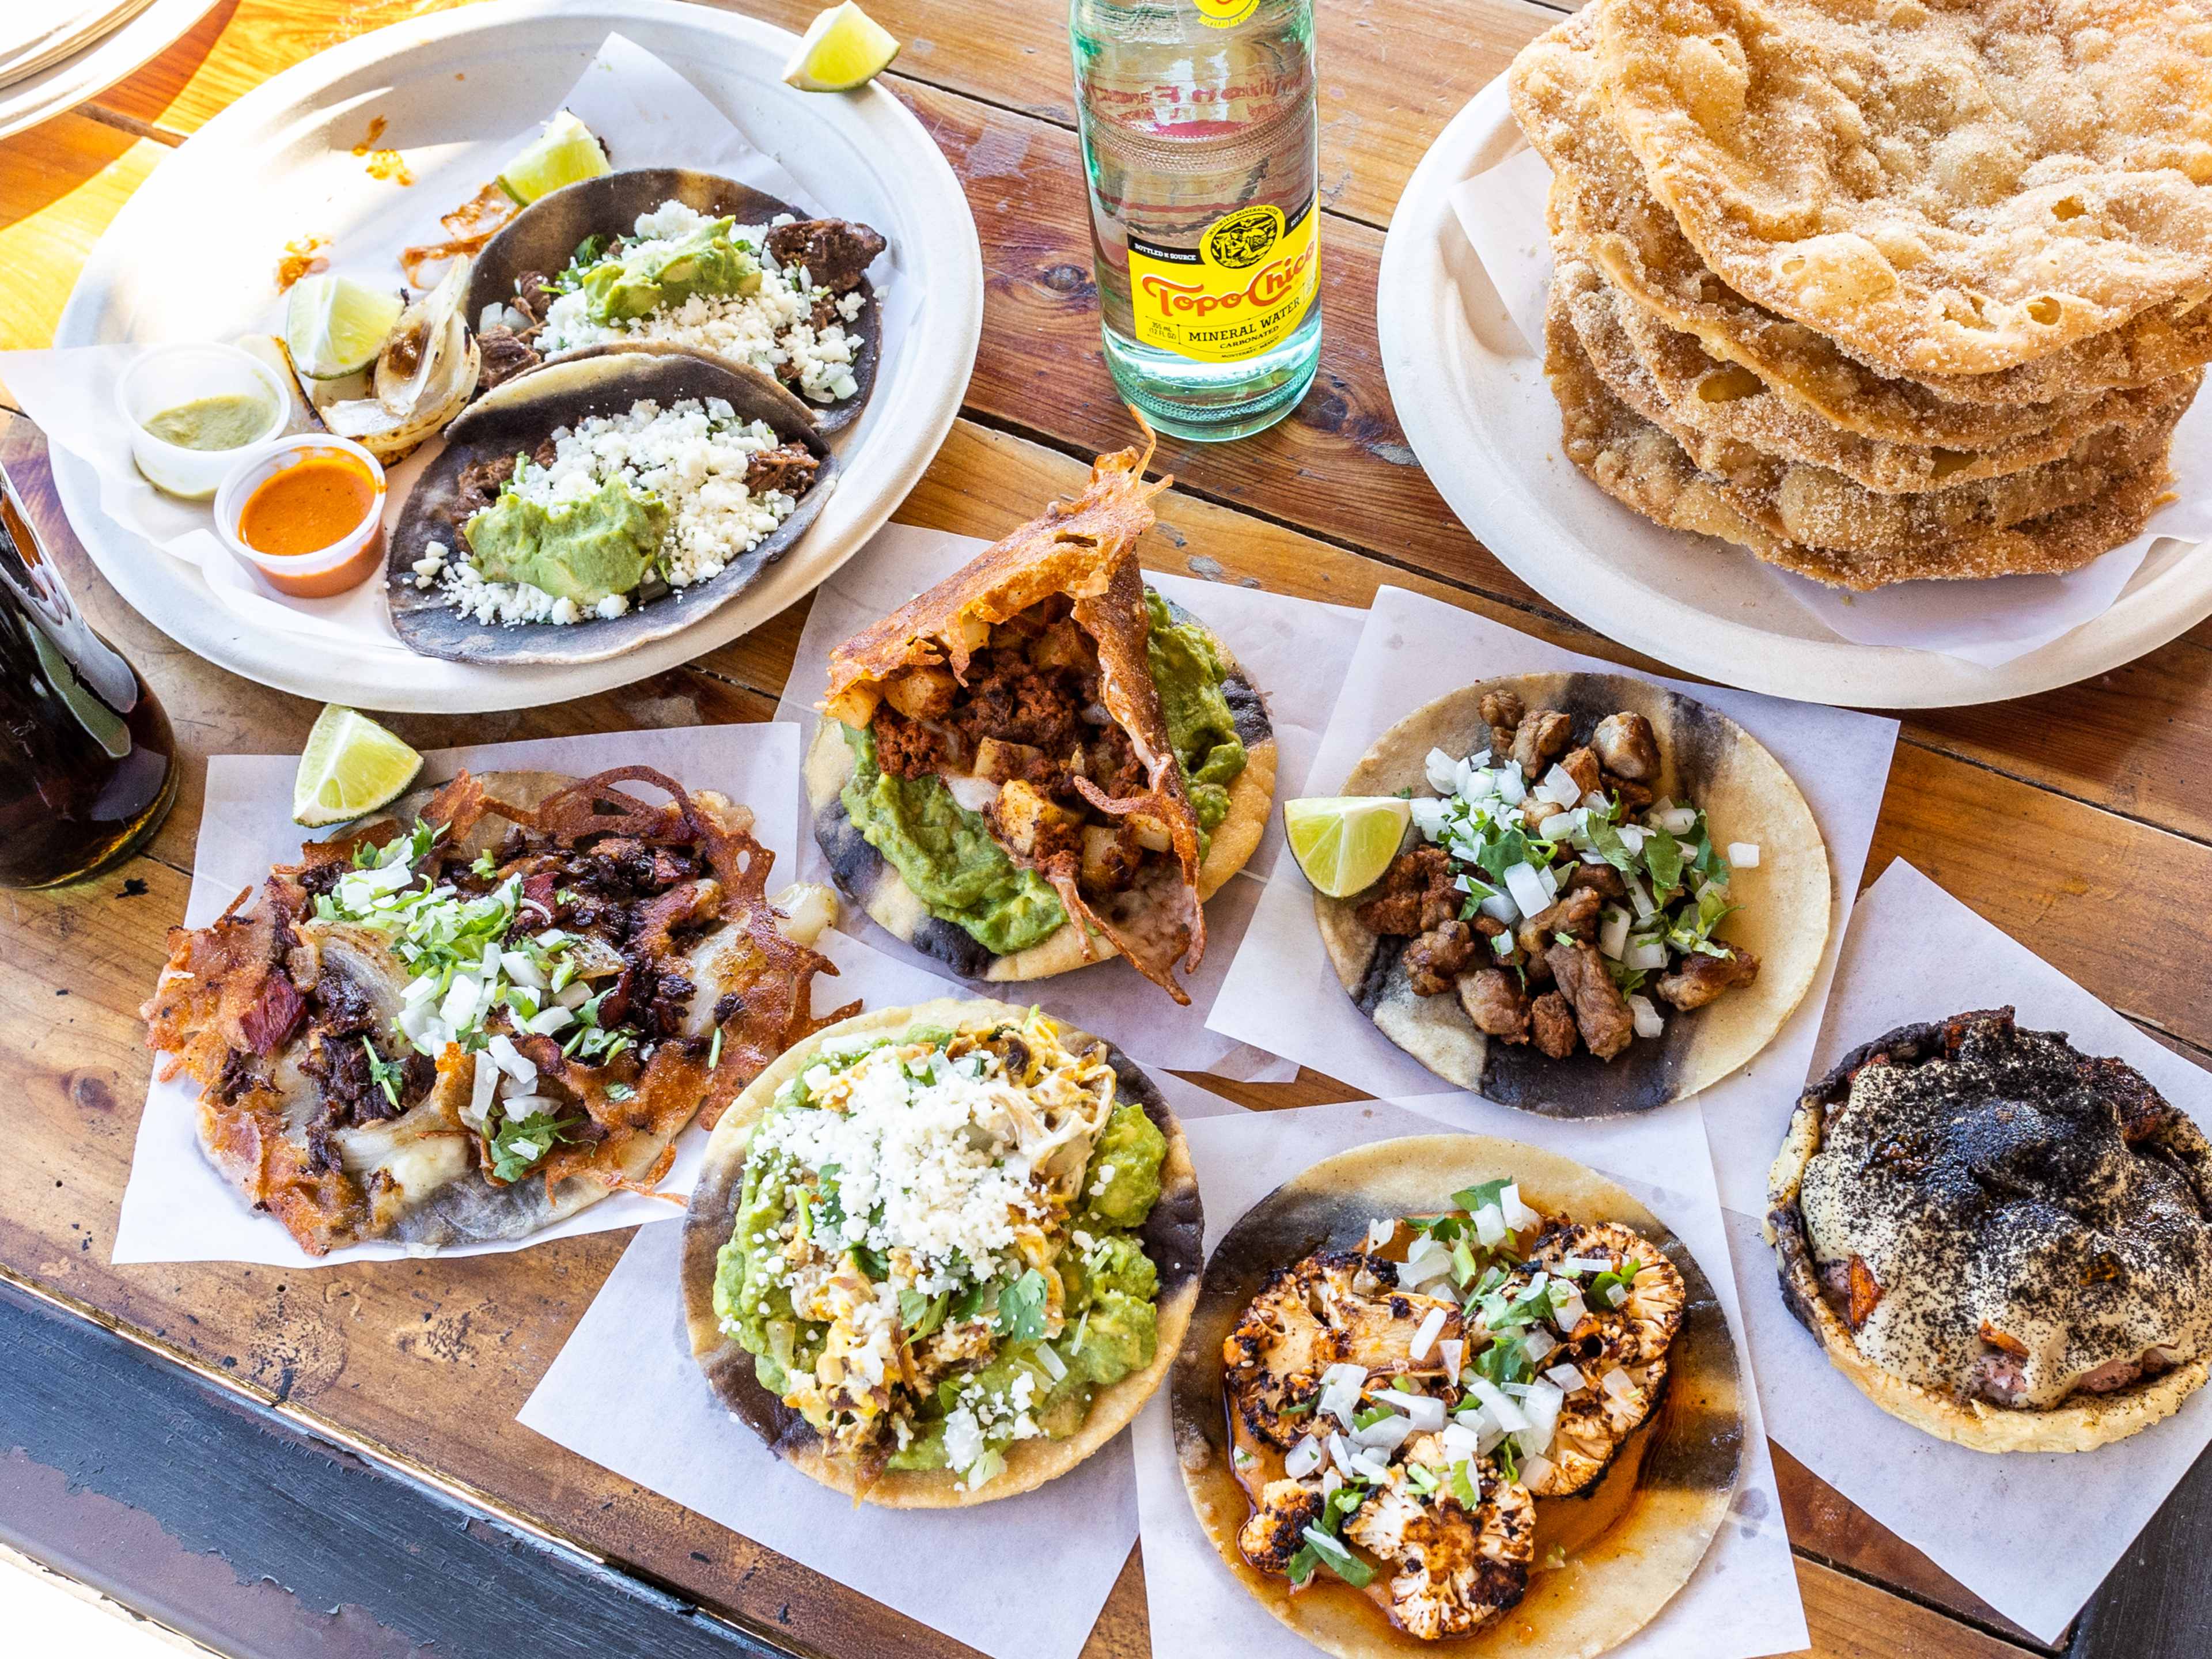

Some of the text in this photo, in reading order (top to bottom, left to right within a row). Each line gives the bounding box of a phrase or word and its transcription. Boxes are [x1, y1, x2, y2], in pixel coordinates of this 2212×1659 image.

[1134, 243, 1163, 257] BOTTLED
[1169, 253, 1196, 261] SOURCE
[1142, 273, 1242, 317] Topo
[1247, 240, 1315, 307] Chico
[1189, 297, 1300, 342] MINERAL WATER
[1219, 325, 1279, 349] CARBONATED
